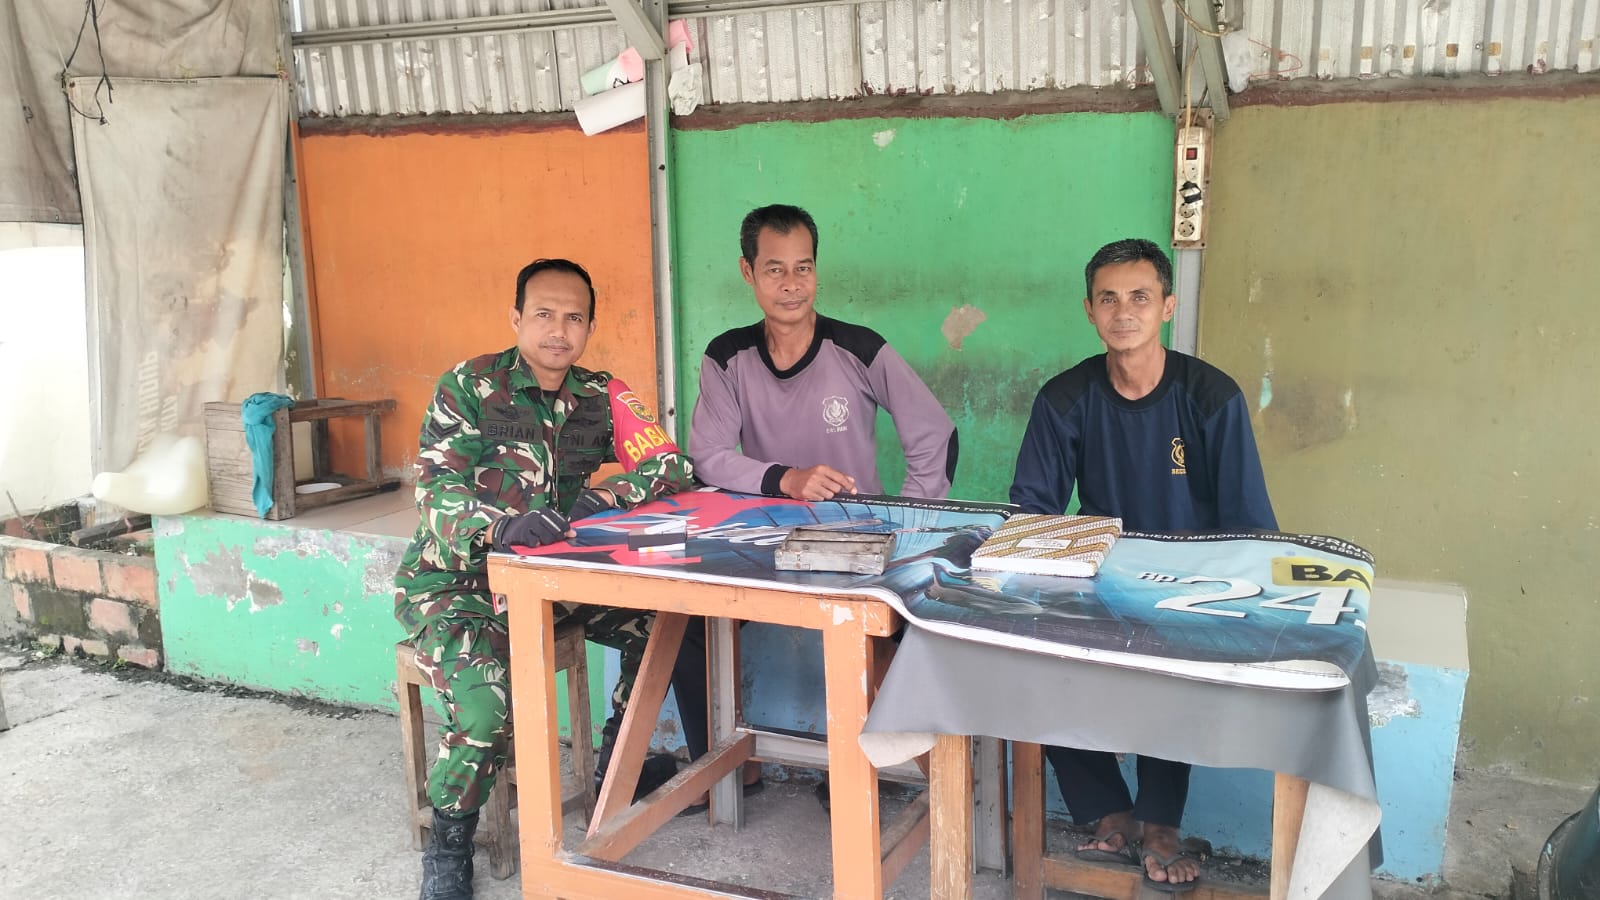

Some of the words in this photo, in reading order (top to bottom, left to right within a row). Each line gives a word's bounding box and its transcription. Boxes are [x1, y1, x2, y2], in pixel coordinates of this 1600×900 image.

[487, 423, 535, 440] BRIAN
[1187, 533, 1257, 541] MEROKOK
[1137, 571, 1178, 583] Rp
